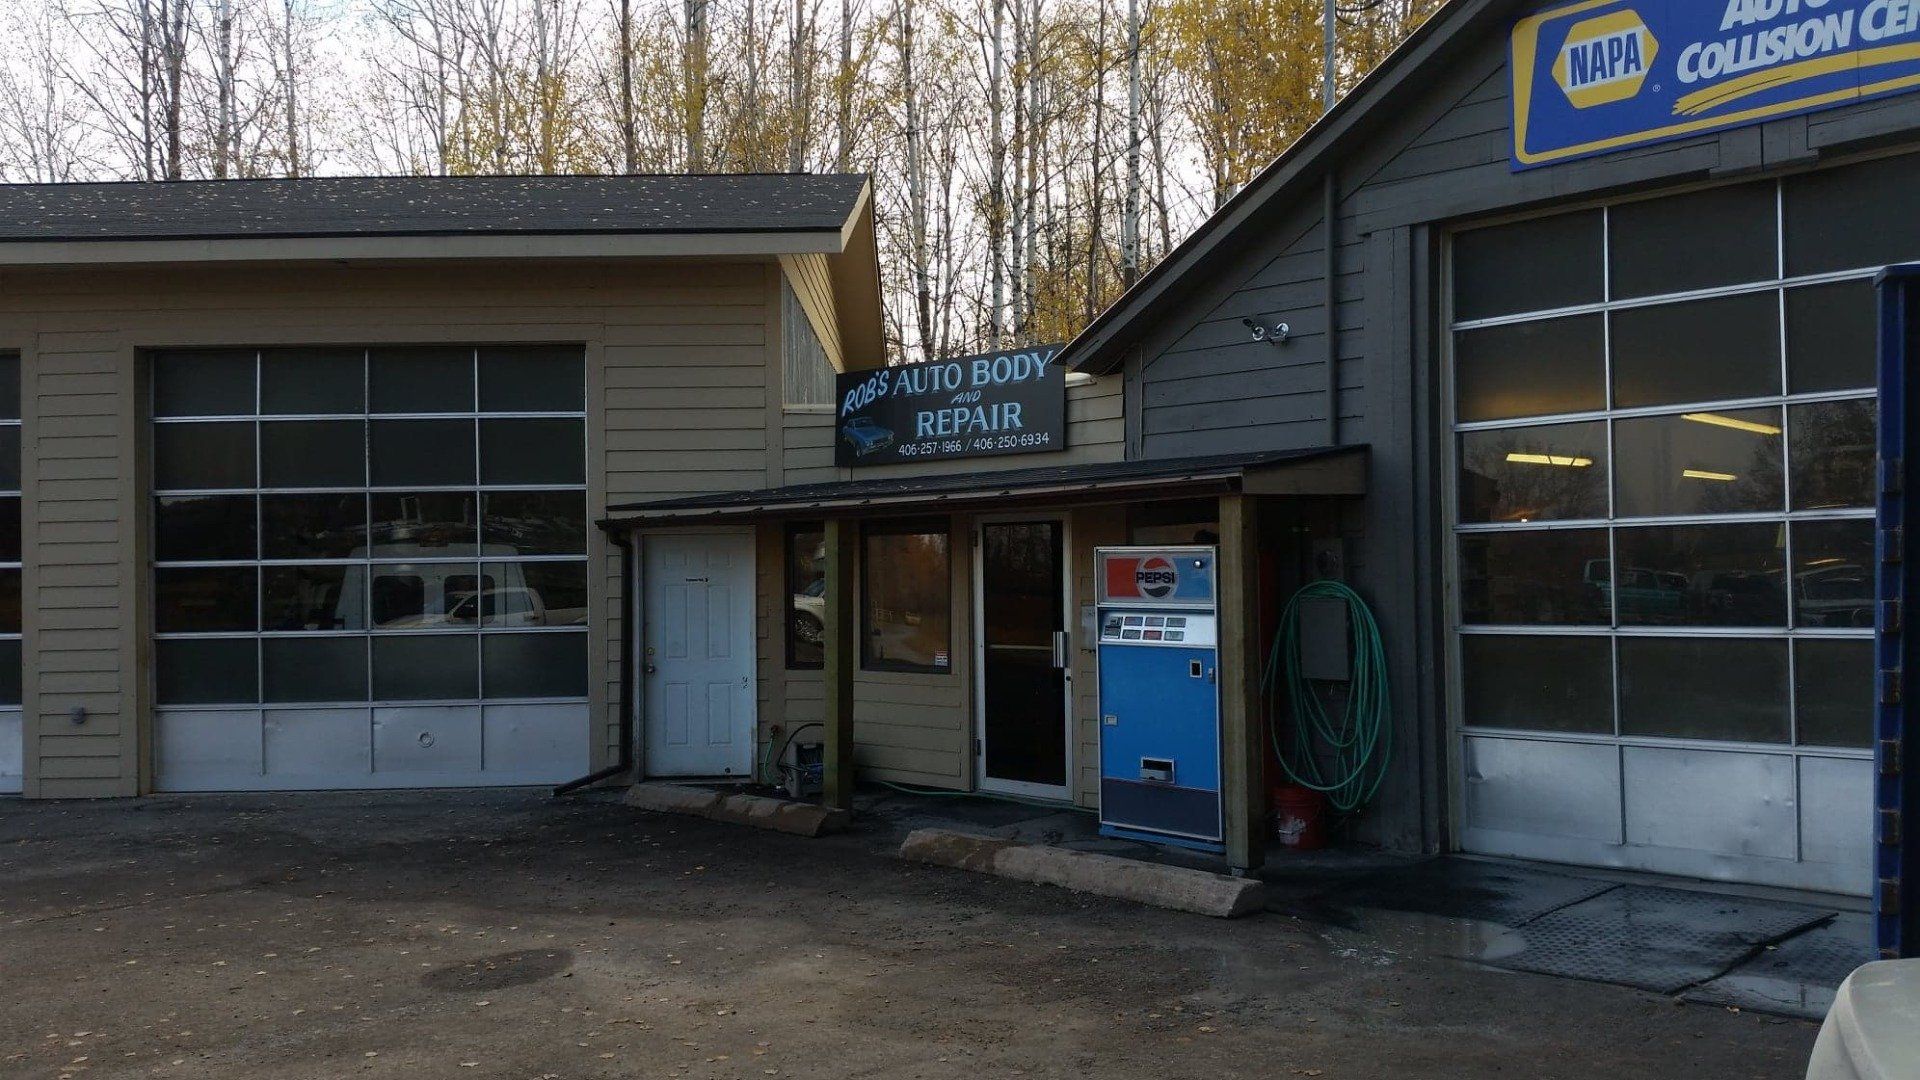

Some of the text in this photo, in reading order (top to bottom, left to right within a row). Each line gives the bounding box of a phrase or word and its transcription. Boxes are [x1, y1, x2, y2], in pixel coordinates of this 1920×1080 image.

[1719, 0, 1831, 31] AU
[1570, 32, 1642, 87] NAPA
[1676, 9, 1855, 84] COLLISION
[841, 350, 1054, 417] ROB'S AUTO BODY
[950, 389, 982, 404] AND
[916, 402, 1023, 438] REPAIR
[1136, 571, 1175, 584] PEPSI
